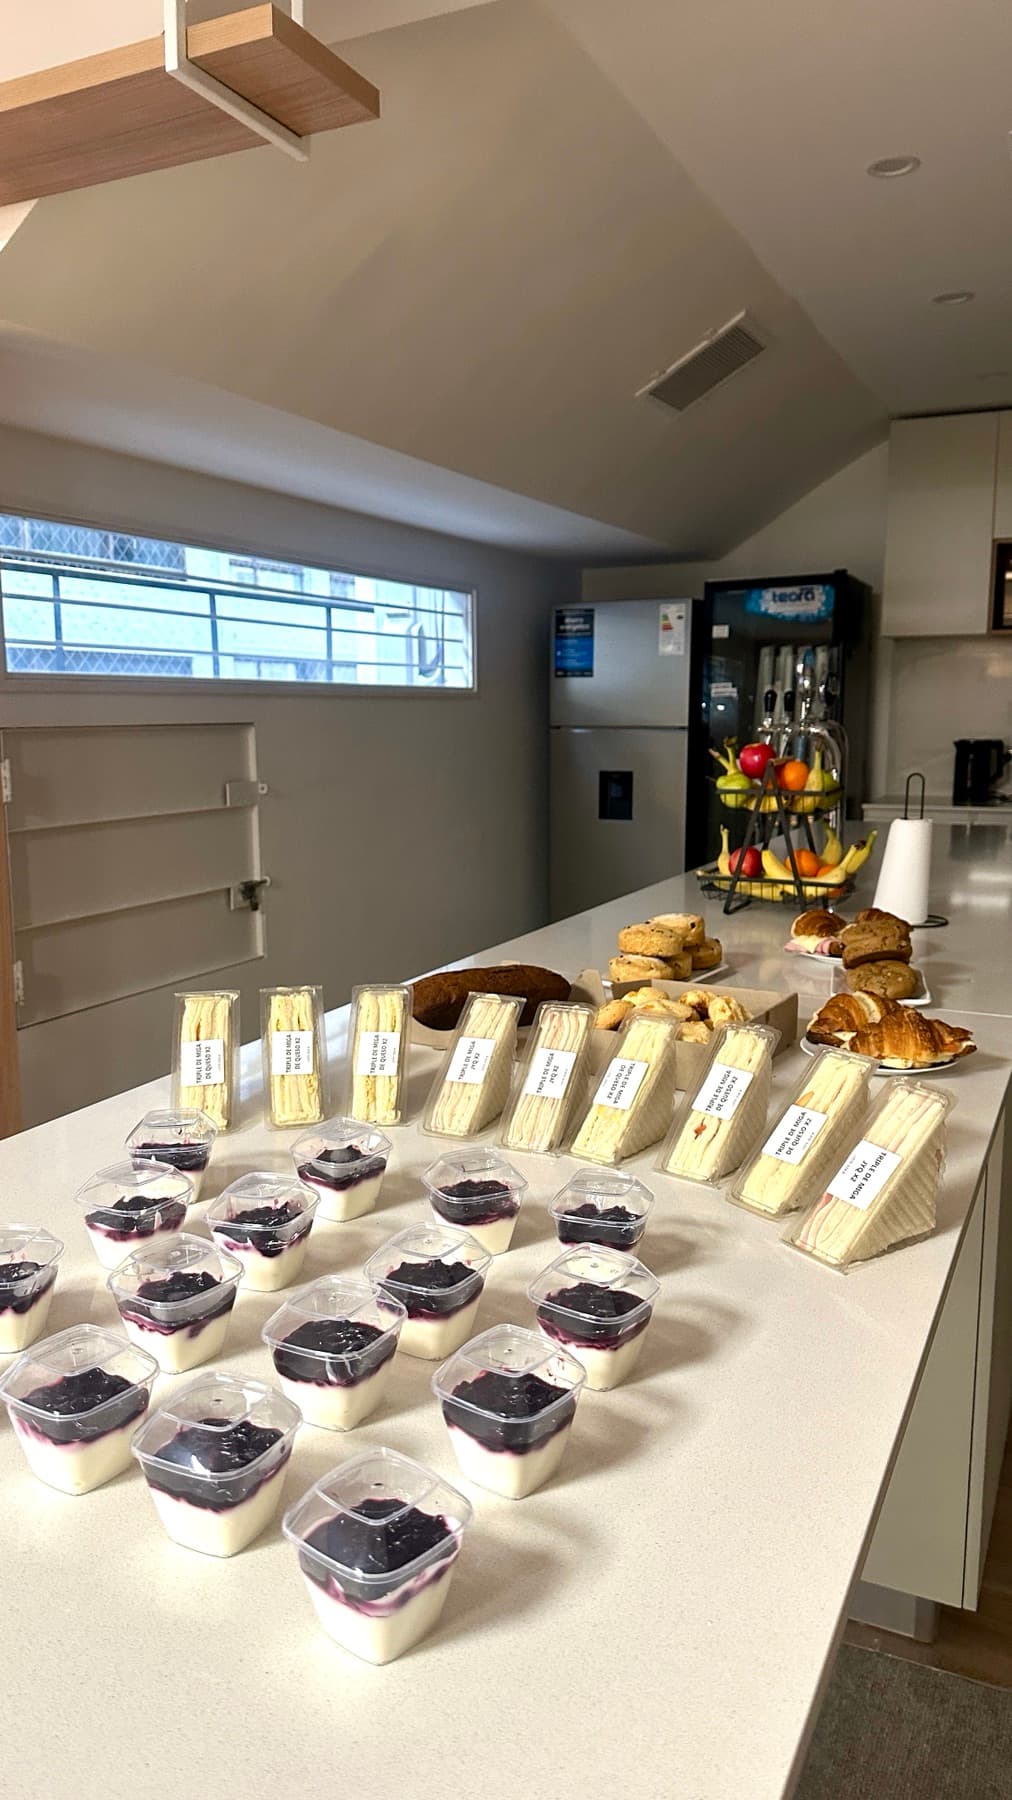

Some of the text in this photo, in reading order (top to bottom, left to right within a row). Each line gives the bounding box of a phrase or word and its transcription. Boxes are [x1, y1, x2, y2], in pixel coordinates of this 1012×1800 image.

[705, 1070, 731, 1111] TRIPLE DE MIGA
[716, 1103, 724, 1111] DE
[720, 1084, 734, 1103] QUESO
[731, 1076, 738, 1084] X2
[775, 1112, 806, 1156] TRIPLE DE MIGA
[786, 1147, 794, 1156] DE
[792, 1126, 806, 1146] QUESO
[804, 1118, 812, 1126] X2
[850, 1160, 868, 1182] JYQ X2
[869, 1152, 887, 1172] TRIPLE
[849, 1182, 865, 1200] MIGA
[862, 1172, 872, 1182] DE
